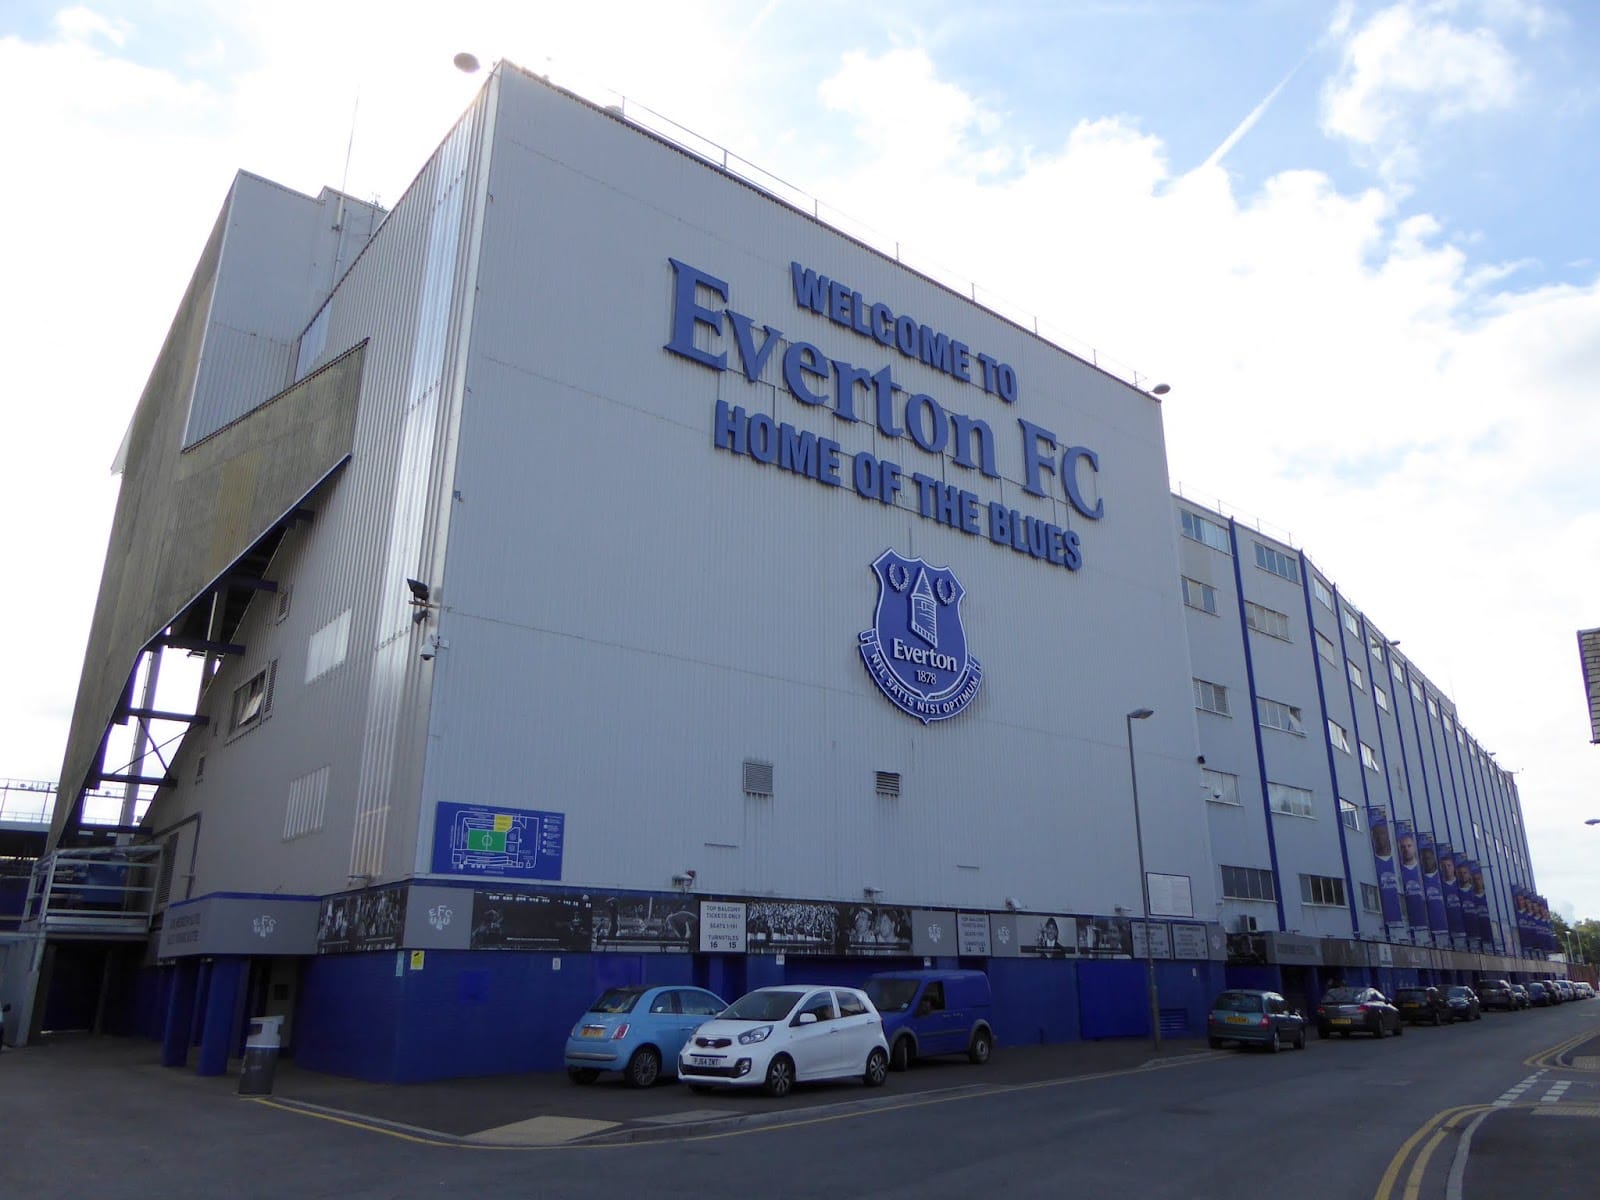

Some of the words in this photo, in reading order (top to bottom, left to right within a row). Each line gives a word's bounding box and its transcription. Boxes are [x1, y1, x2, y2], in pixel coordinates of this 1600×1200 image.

[790, 261, 971, 383] WELCOME
[977, 352, 1018, 403] TO
[663, 257, 1001, 479] Everton
[1017, 418, 1104, 520] FC
[714, 400, 841, 487] HOME
[852, 452, 902, 505] OF
[913, 472, 981, 536] THE
[988, 501, 1083, 571] BLUES
[871, 653, 885, 678] NIL
[886, 678, 914, 706] SATIS
[917, 702, 940, 714] NISI
[943, 676, 979, 713] OPTIMUM
[893, 638, 957, 672] Everton
[916, 670, 937, 685] 1878
